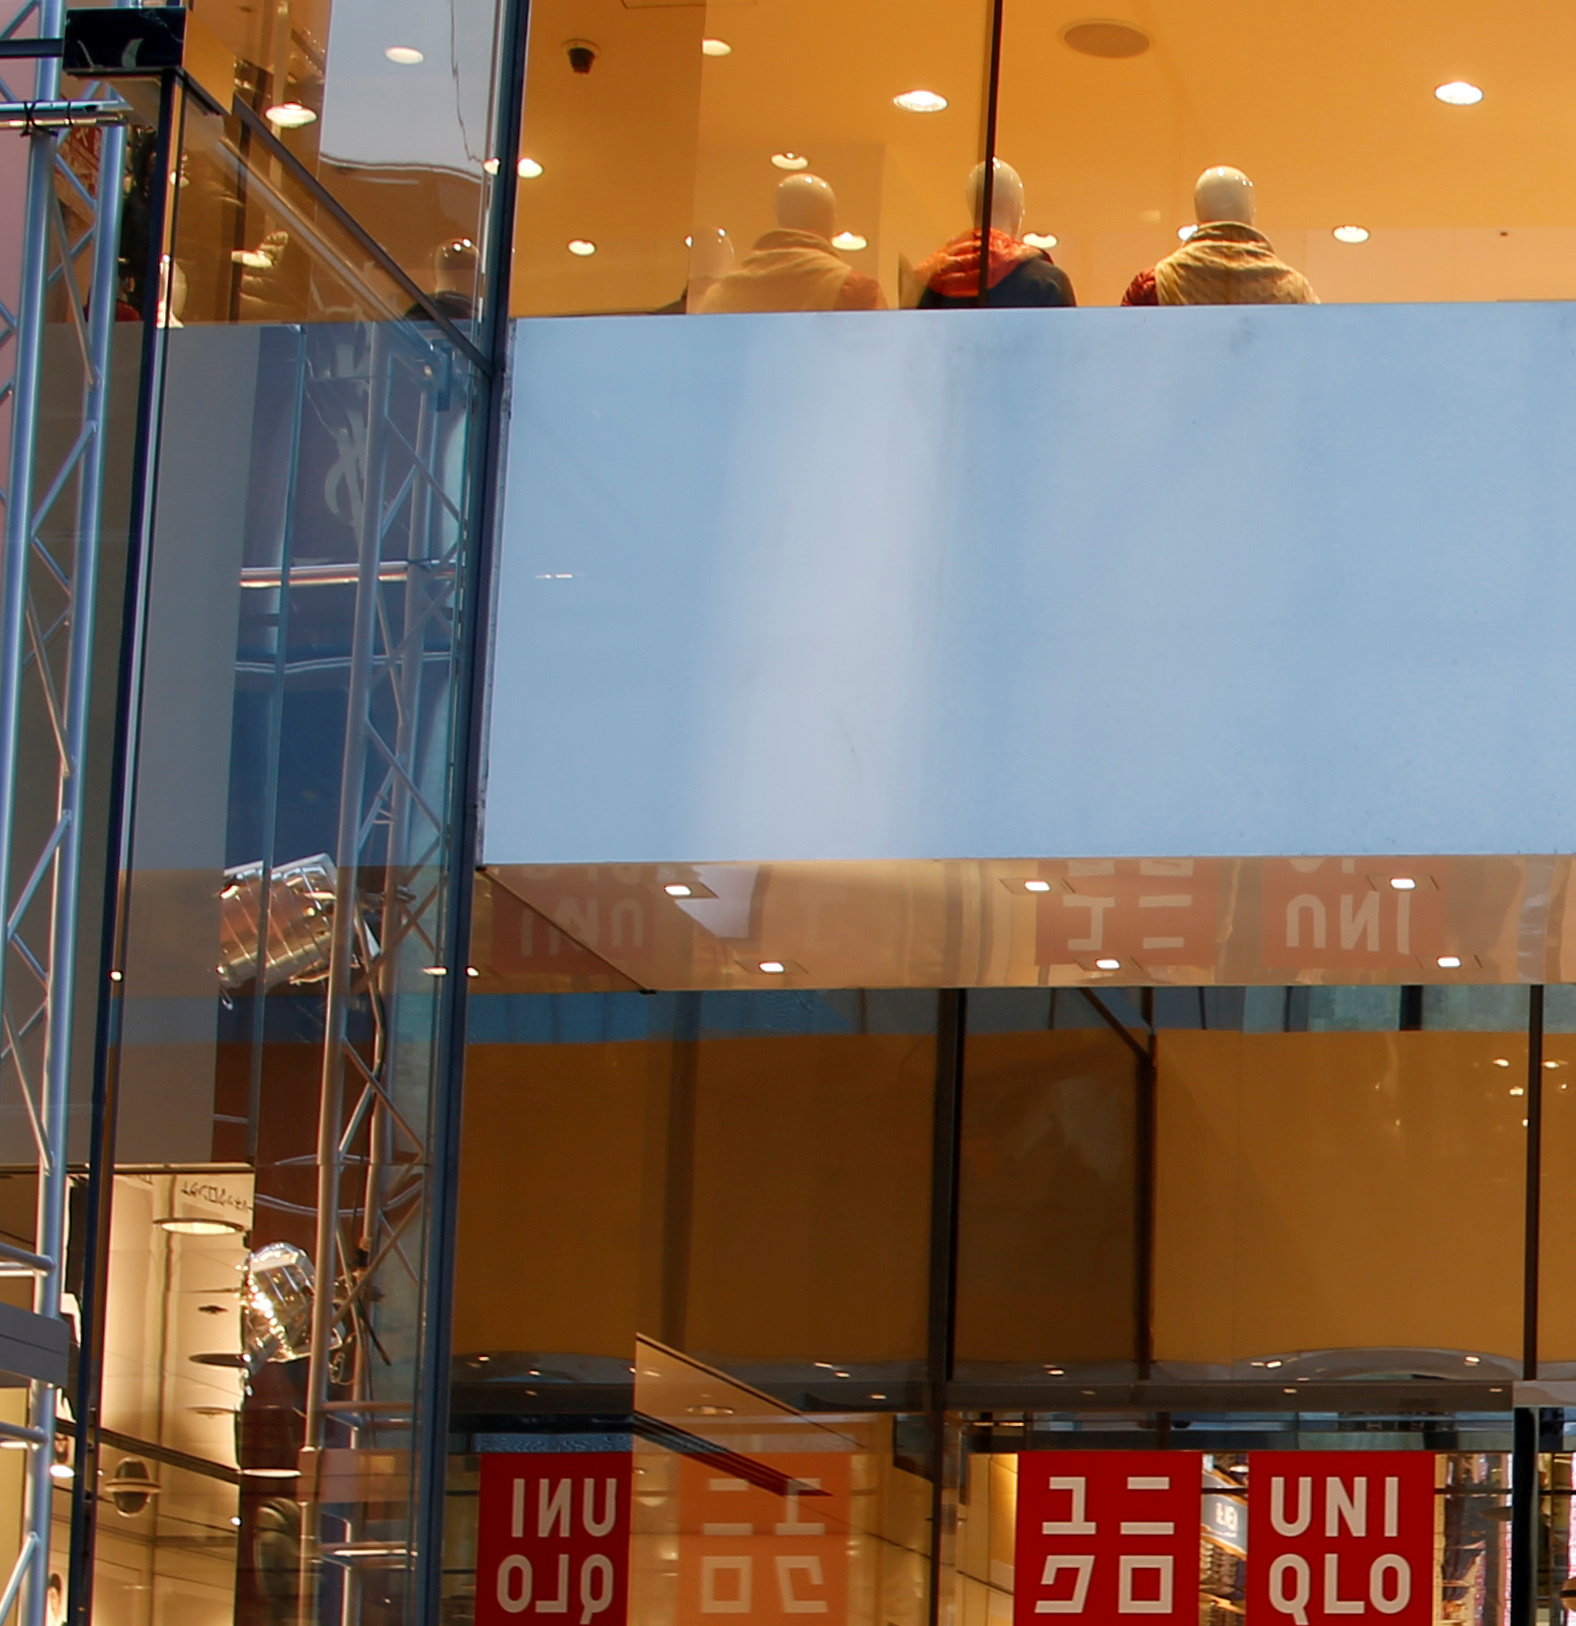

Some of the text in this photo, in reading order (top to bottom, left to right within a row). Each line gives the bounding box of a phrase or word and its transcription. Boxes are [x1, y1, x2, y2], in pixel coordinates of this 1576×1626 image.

[1041, 1476, 1175, 1535] ユニ
[1269, 1476, 1400, 1538] UNI
[1033, 1555, 1174, 1614] クロ
[1268, 1553, 1412, 1626] QLO
